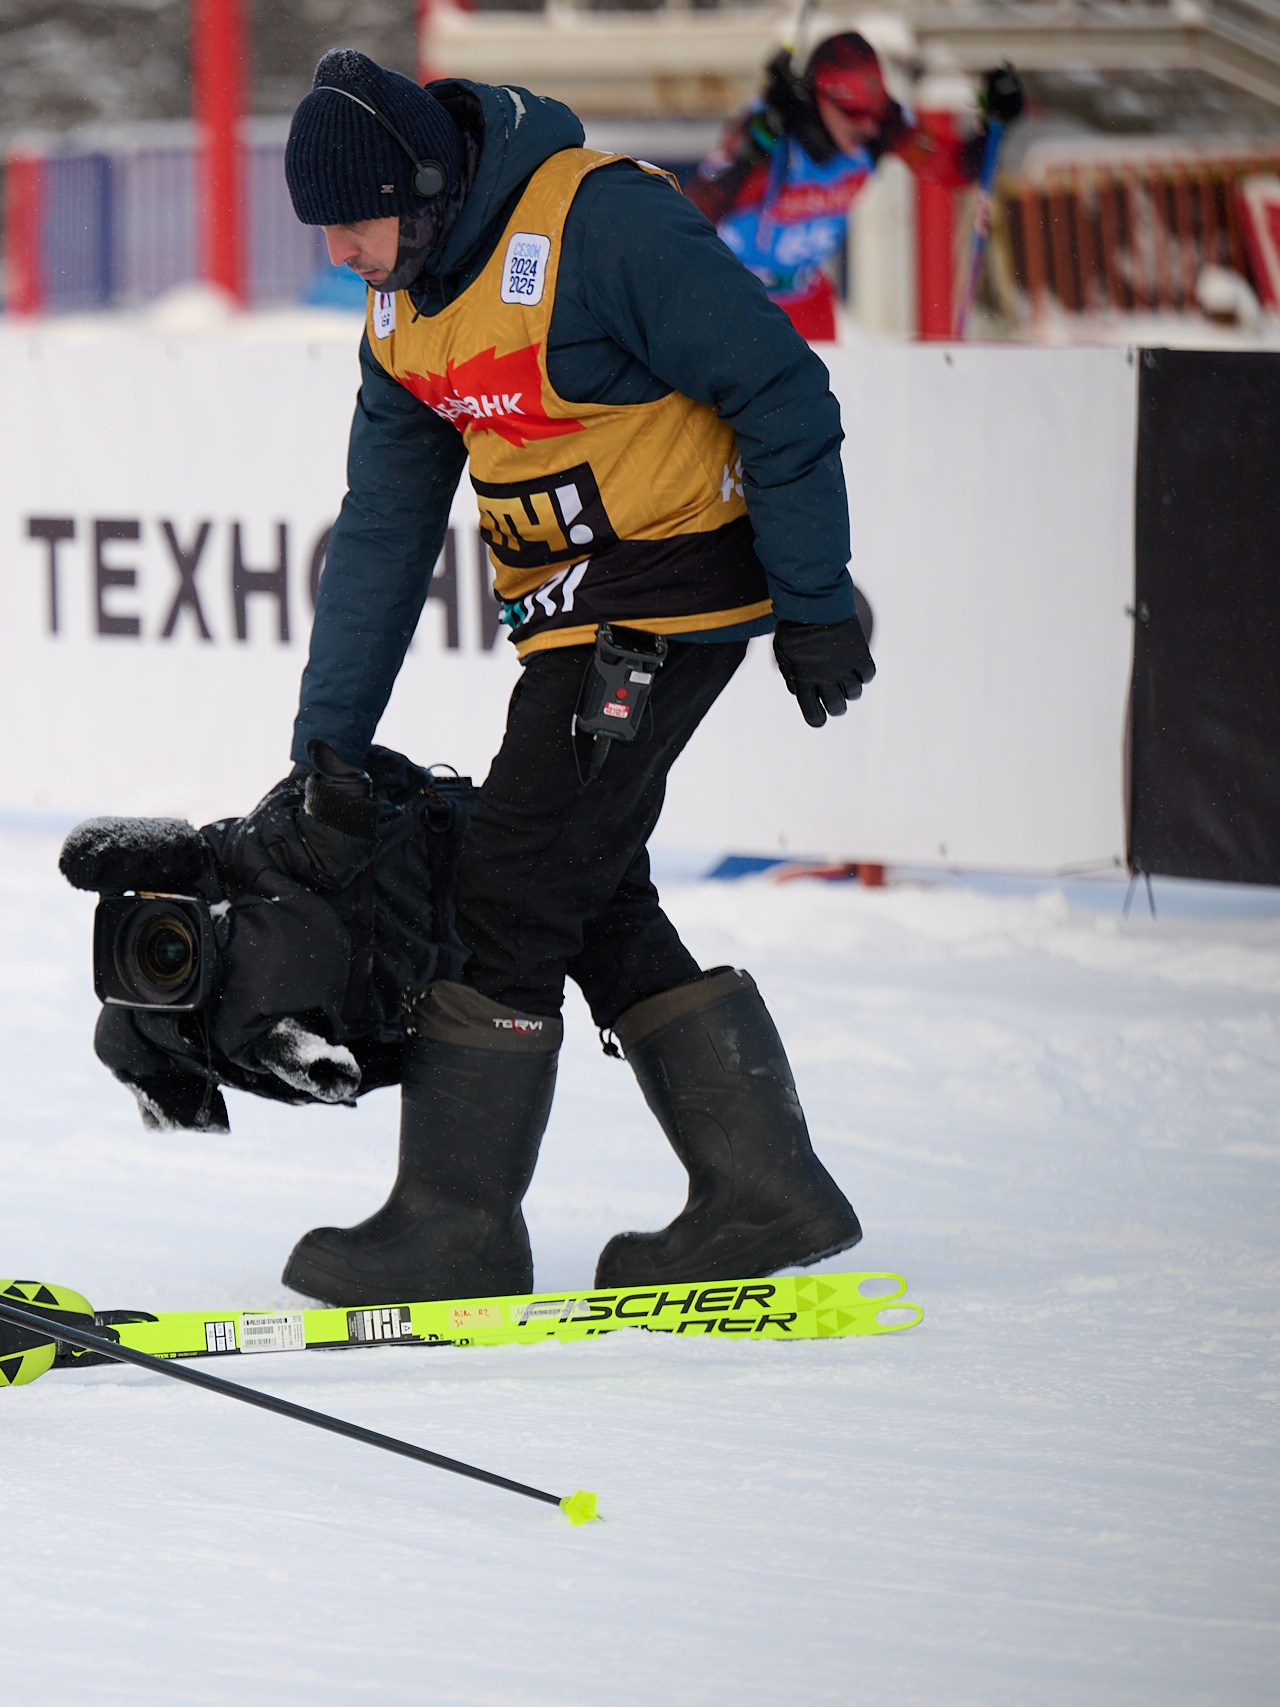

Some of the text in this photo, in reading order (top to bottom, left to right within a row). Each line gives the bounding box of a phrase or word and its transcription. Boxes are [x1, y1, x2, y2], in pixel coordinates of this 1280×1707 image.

[513, 242, 541, 258] СЕЗОН
[510, 256, 538, 277] 2024
[509, 275, 536, 296] 2025
[517, 1284, 776, 1326] FISCHER
